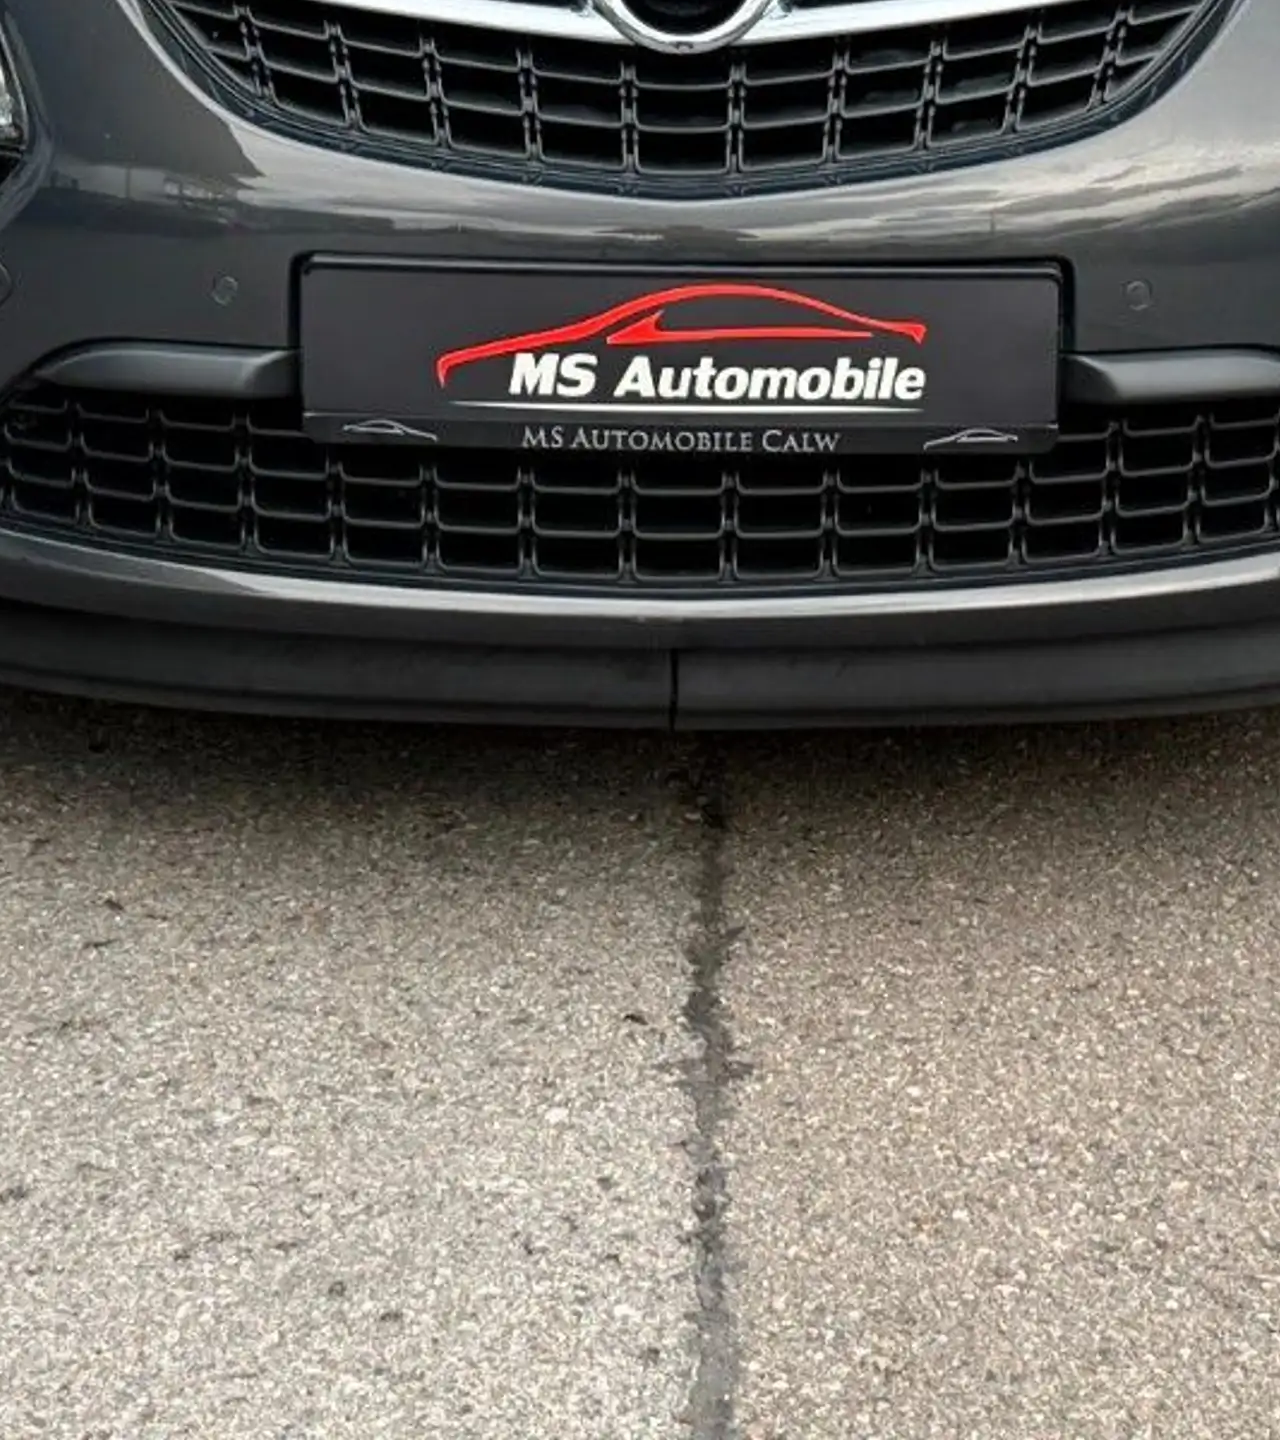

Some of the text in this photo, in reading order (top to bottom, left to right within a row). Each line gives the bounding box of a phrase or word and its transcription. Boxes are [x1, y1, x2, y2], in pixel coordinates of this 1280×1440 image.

[508, 352, 926, 400] MS Automobile
[522, 425, 565, 449] MS
[571, 426, 753, 452] AUTOMOBILE
